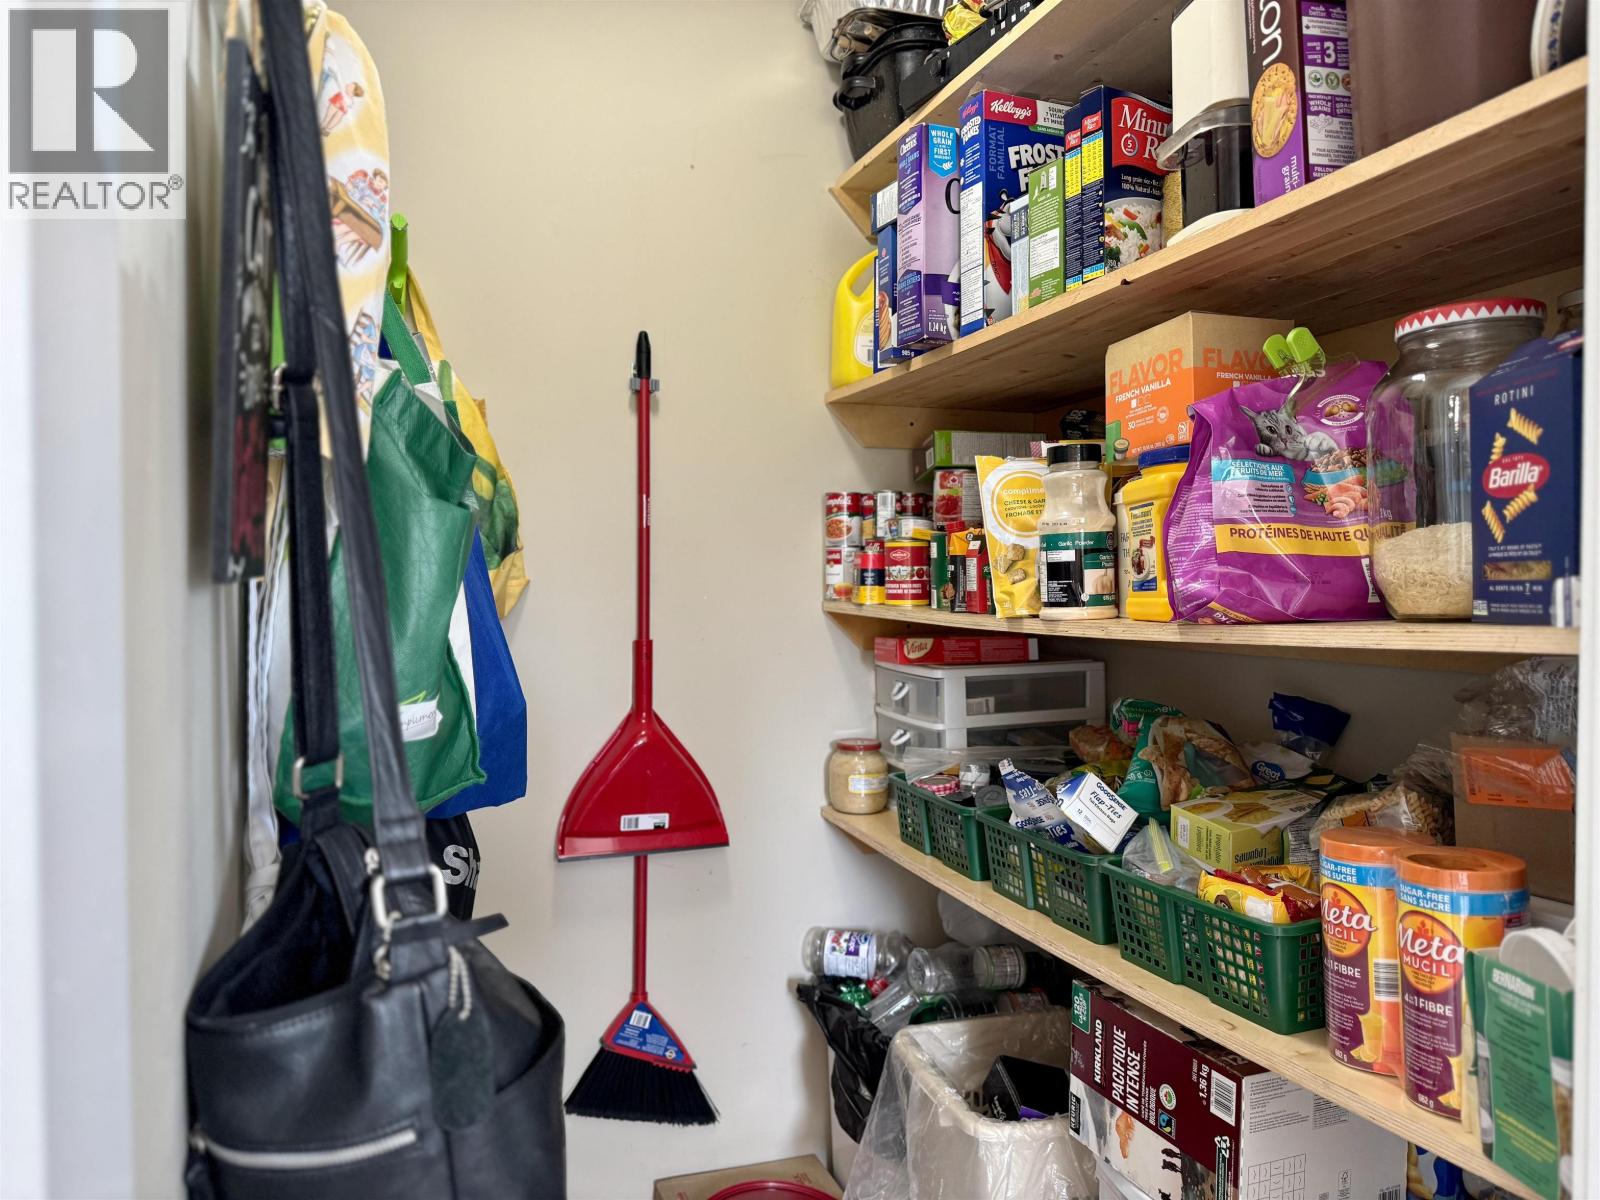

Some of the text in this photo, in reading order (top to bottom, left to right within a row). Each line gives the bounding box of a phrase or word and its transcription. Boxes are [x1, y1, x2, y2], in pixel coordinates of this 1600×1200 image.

[1324, 41, 1336, 64] 3
[990, 99, 1032, 120] Kellogg's
[931, 130, 954, 140] WHOLE
[932, 137, 952, 146] GRAIN
[988, 126, 997, 172] FORMAT
[1282, 166, 1292, 192] grain
[1109, 348, 1183, 394] FLAVOR
[1216, 372, 1243, 380] FRENCH
[1115, 378, 1172, 404] FRENCH VANILLA
[1494, 385, 1534, 406] ROTINI
[1488, 461, 1541, 489] Barilla
[1005, 510, 1034, 518] FROMAGE
[1230, 524, 1299, 540] PROTÉINES
[1300, 528, 1313, 539] DE
[1314, 529, 1350, 542] HAUTE
[1256, 762, 1281, 780] Great
[1090, 791, 1122, 818] Flap-Ties
[1046, 824, 1068, 839] Ties
[1332, 872, 1357, 884] SUCRE
[1400, 884, 1450, 903] SUGAR-FREE
[1400, 893, 1450, 912] SANS SUCRE
[1399, 923, 1465, 964] Meta
[1334, 961, 1362, 978] FIBRE
[1403, 955, 1450, 977] MUCIL
[1419, 1000, 1454, 1016] FIBRE
[1094, 1019, 1103, 1084] KIRKLAND
[1112, 1026, 1127, 1104] PACIFIQUE
[1202, 1064, 1210, 1078] kg
[1126, 1047, 1141, 1114] INTENSE
